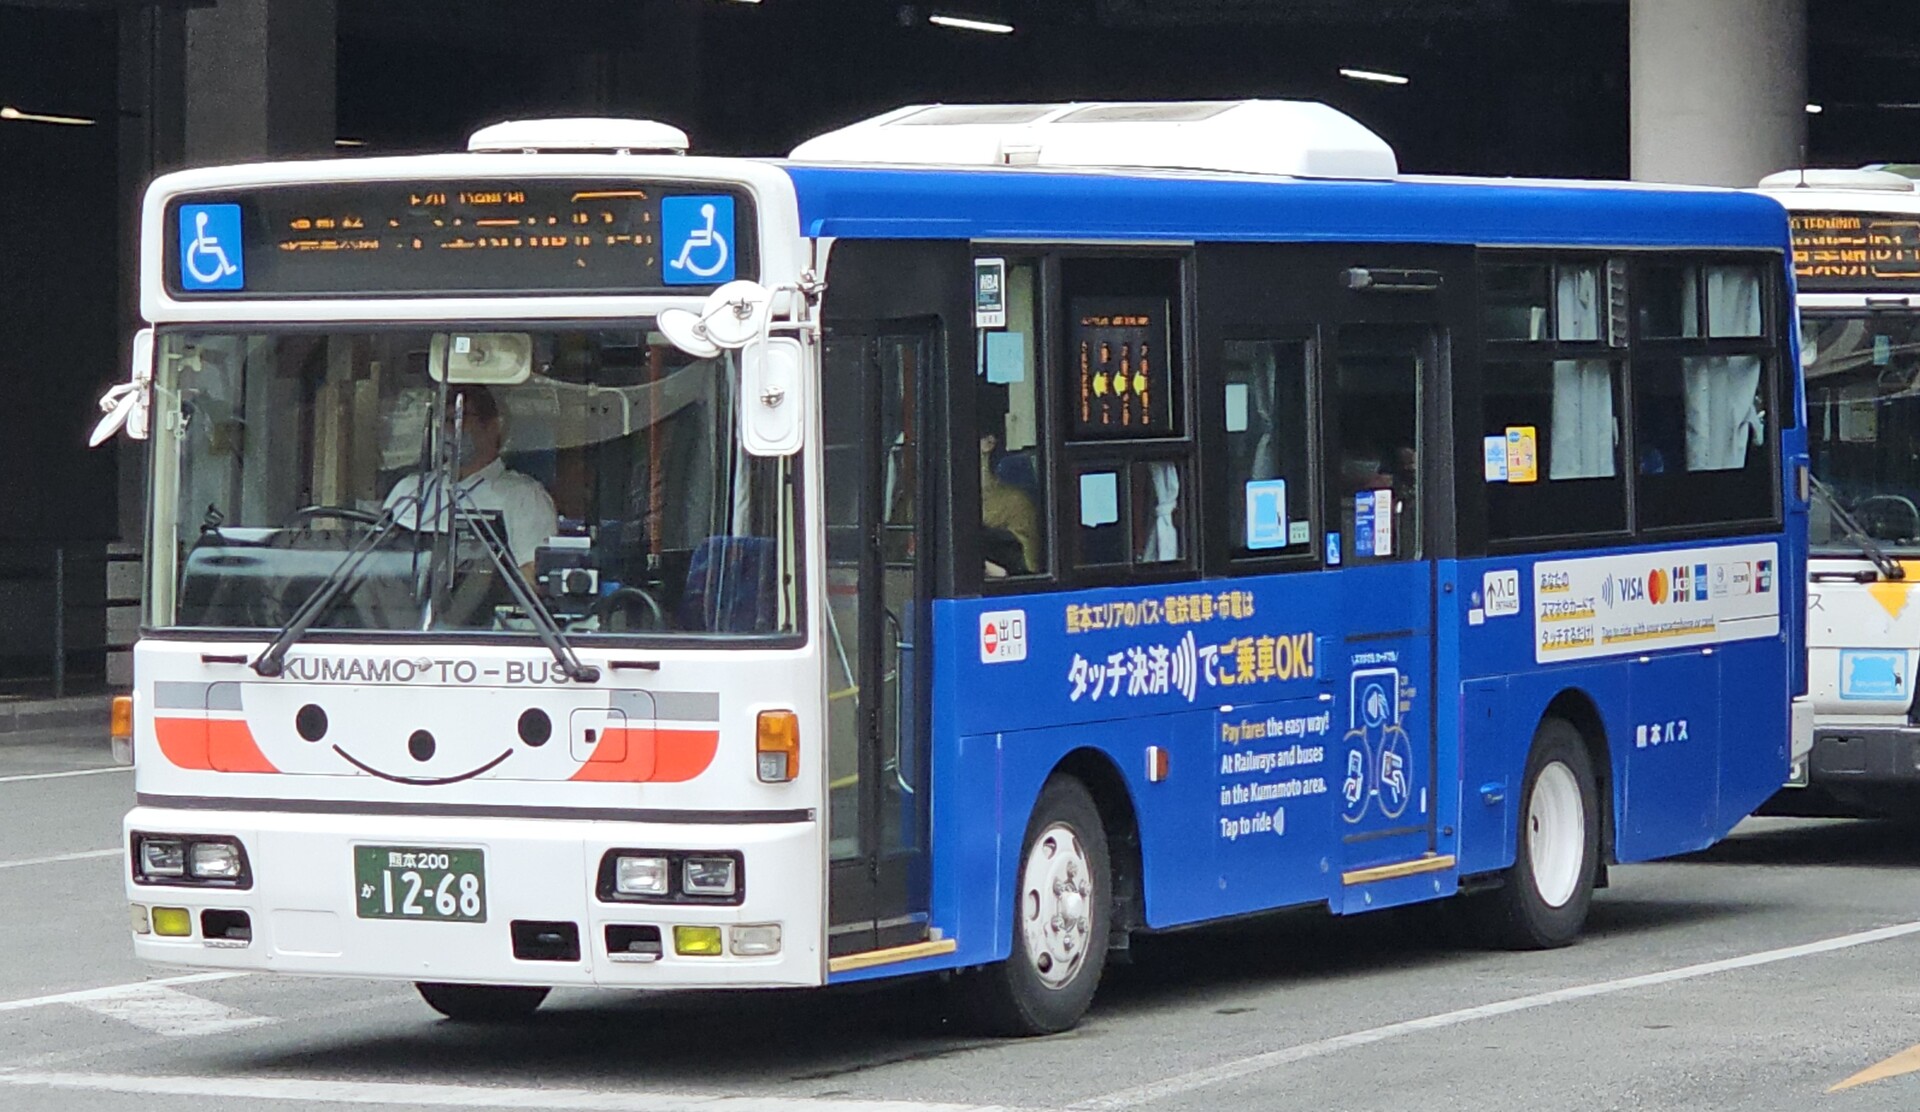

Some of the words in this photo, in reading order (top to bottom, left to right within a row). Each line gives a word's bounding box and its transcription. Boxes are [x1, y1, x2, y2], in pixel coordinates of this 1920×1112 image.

[1497, 577, 1515, 598] 入口
[1618, 576, 1644, 602] VISA
[999, 619, 1022, 642] 出口
[1222, 723, 1239, 745] Pay
[1241, 719, 1265, 740] fares
[1267, 716, 1283, 737] the
[1285, 718, 1305, 738] easy
[1307, 710, 1329, 736] way!
[1220, 754, 1233, 774] At
[1234, 750, 1276, 773] Railways
[1278, 745, 1295, 767] and
[1297, 744, 1323, 764] buses
[1221, 785, 1231, 806] in
[1232, 783, 1249, 805] the
[1250, 778, 1302, 802] Kumamoto
[1220, 818, 1239, 841] Tap
[1240, 816, 1250, 835] to
[1252, 811, 1272, 833] ride
[383, 869, 481, 917] 12-68
